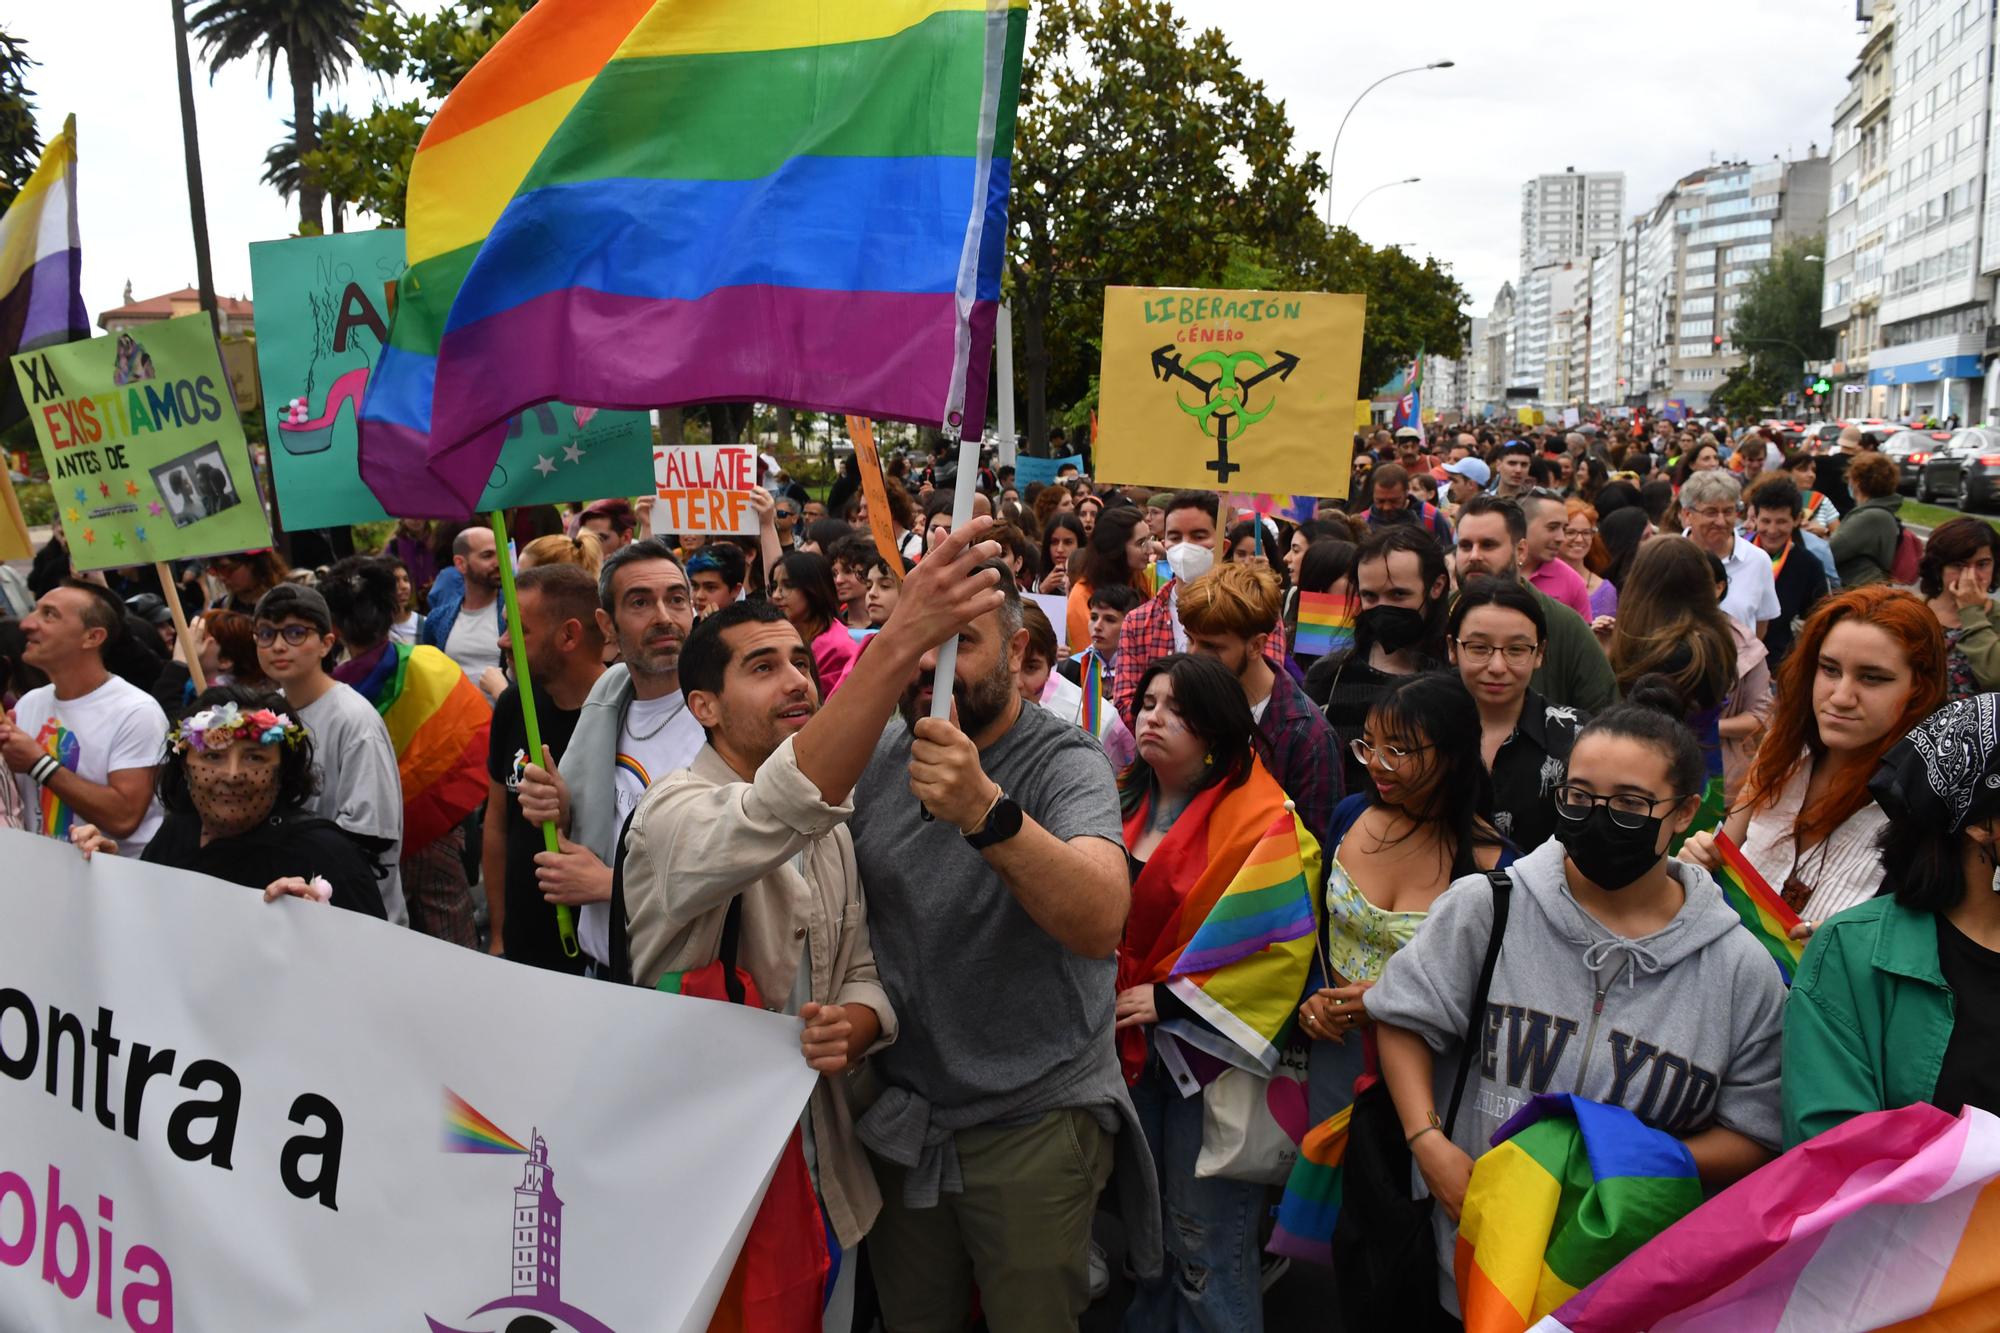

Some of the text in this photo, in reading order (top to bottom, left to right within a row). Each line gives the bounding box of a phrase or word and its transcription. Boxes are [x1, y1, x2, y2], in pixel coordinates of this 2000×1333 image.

[1144, 296, 1301, 324] LIBERACIÓN
[1176, 323, 1245, 343] GÉNERO
[19, 353, 64, 404] XA
[43, 375, 222, 450] EXISTIAMOS
[55, 444, 130, 479] ANTES DE
[659, 489, 750, 532] TERF
[280, 1092, 344, 1212] a
